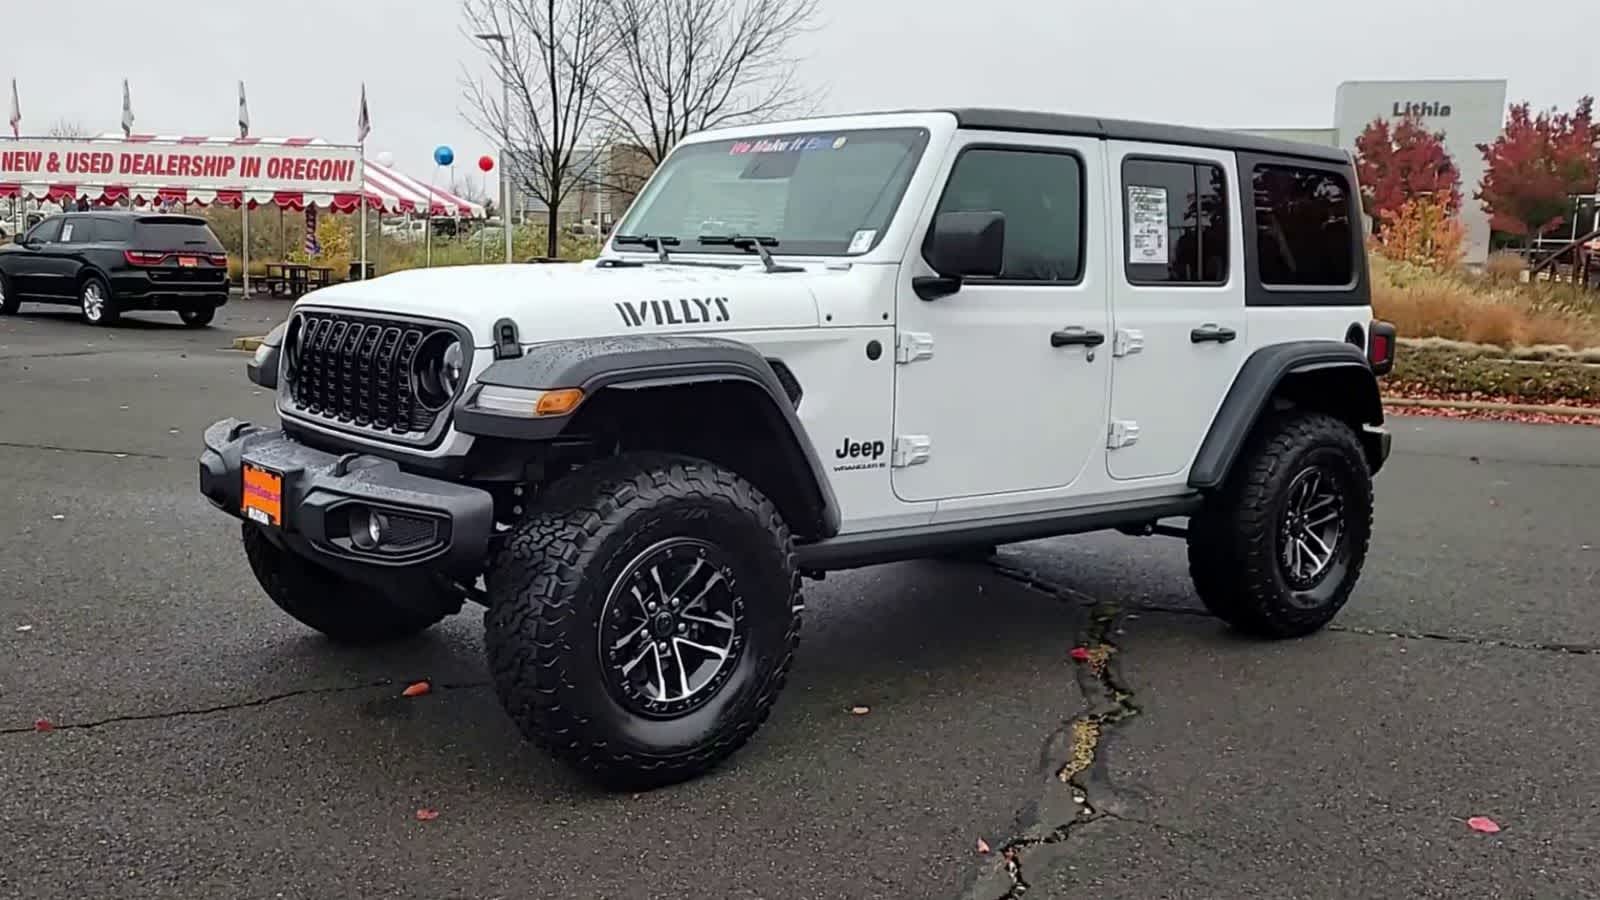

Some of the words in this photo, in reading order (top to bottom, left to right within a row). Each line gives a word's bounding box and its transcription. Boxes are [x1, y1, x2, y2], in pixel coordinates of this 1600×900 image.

[1393, 101, 1451, 117] Lithia
[2, 152, 42, 172] NEW
[47, 152, 61, 173] &
[66, 152, 113, 174] USED
[119, 153, 236, 177] DEALERSHIP
[240, 156, 262, 178] IN
[267, 157, 355, 182] OREGON!
[614, 297, 730, 327] WILLYS
[835, 437, 885, 460] Jeep
